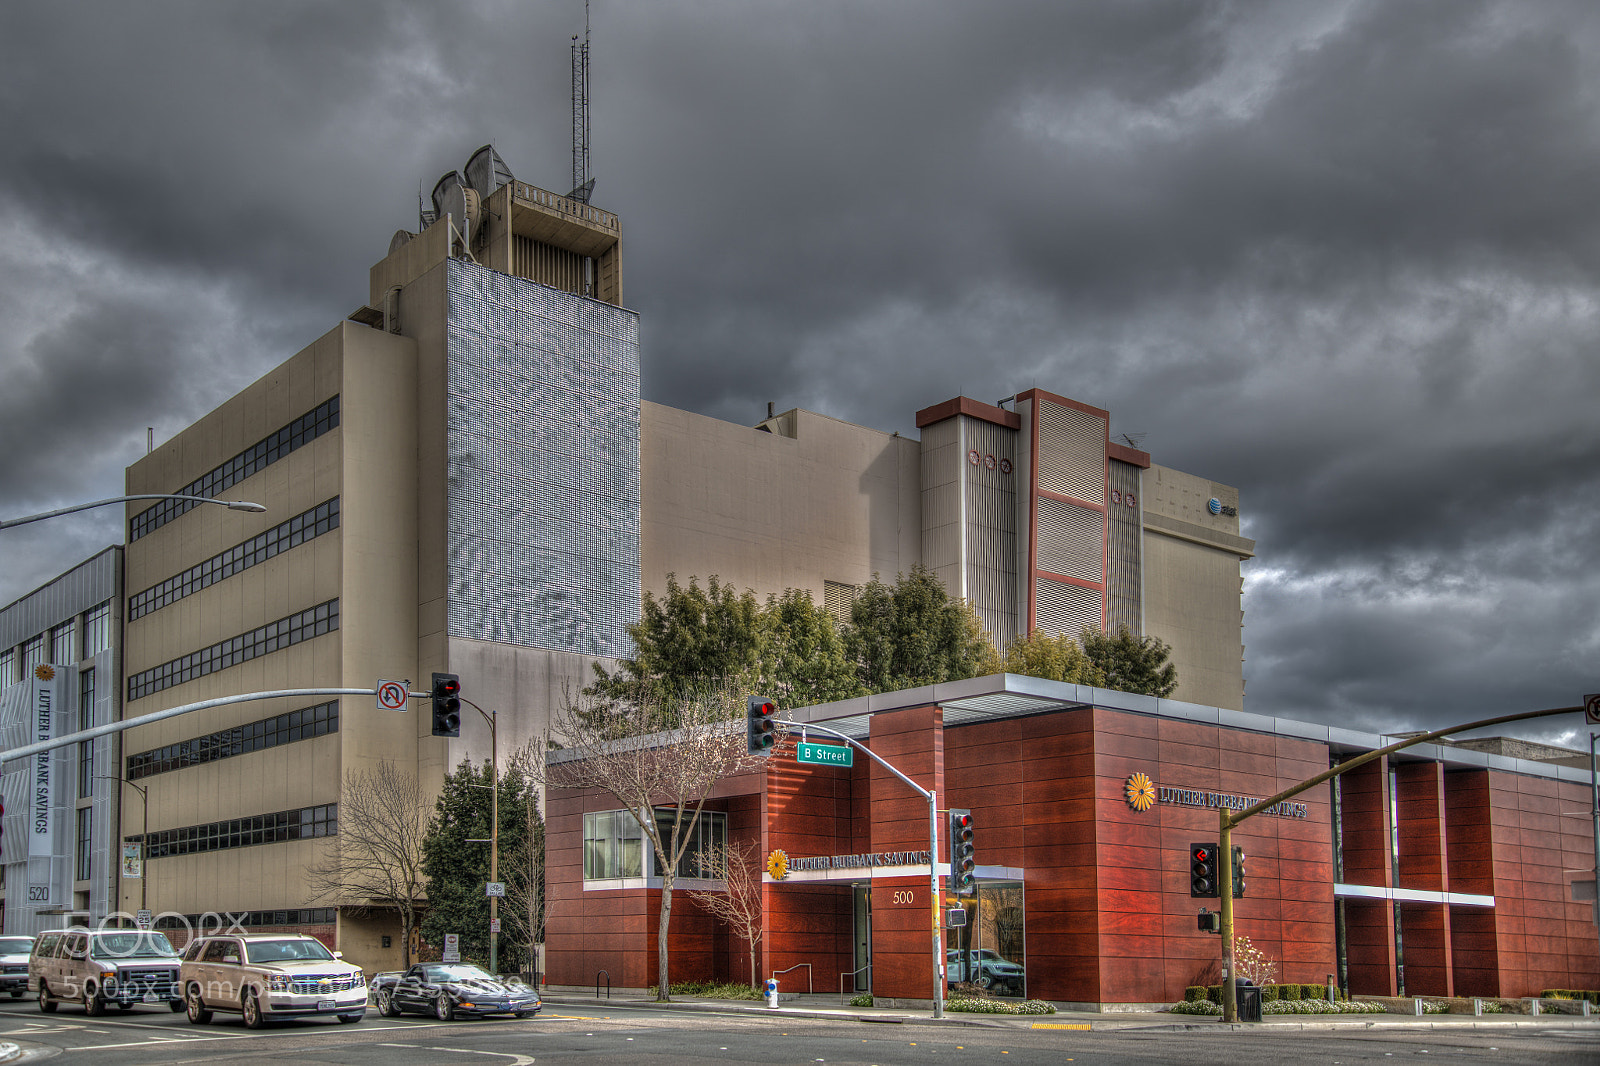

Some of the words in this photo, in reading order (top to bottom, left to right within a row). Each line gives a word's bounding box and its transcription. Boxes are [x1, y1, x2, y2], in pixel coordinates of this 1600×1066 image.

[38, 689, 51, 731] LUTHER
[37, 734, 50, 786] BRBANK
[805, 748, 811, 758] B
[817, 748, 846, 762] Street
[35, 787, 49, 834] SAVINGS
[1159, 787, 1206, 806] LUTHER
[1262, 800, 1308, 818] AVINGS
[790, 857, 831, 871] LUTHER
[832, 853, 884, 870] BURBANK
[884, 850, 932, 866] SAVINGS
[29, 886, 49, 901] 520
[892, 890, 914, 904] 500
